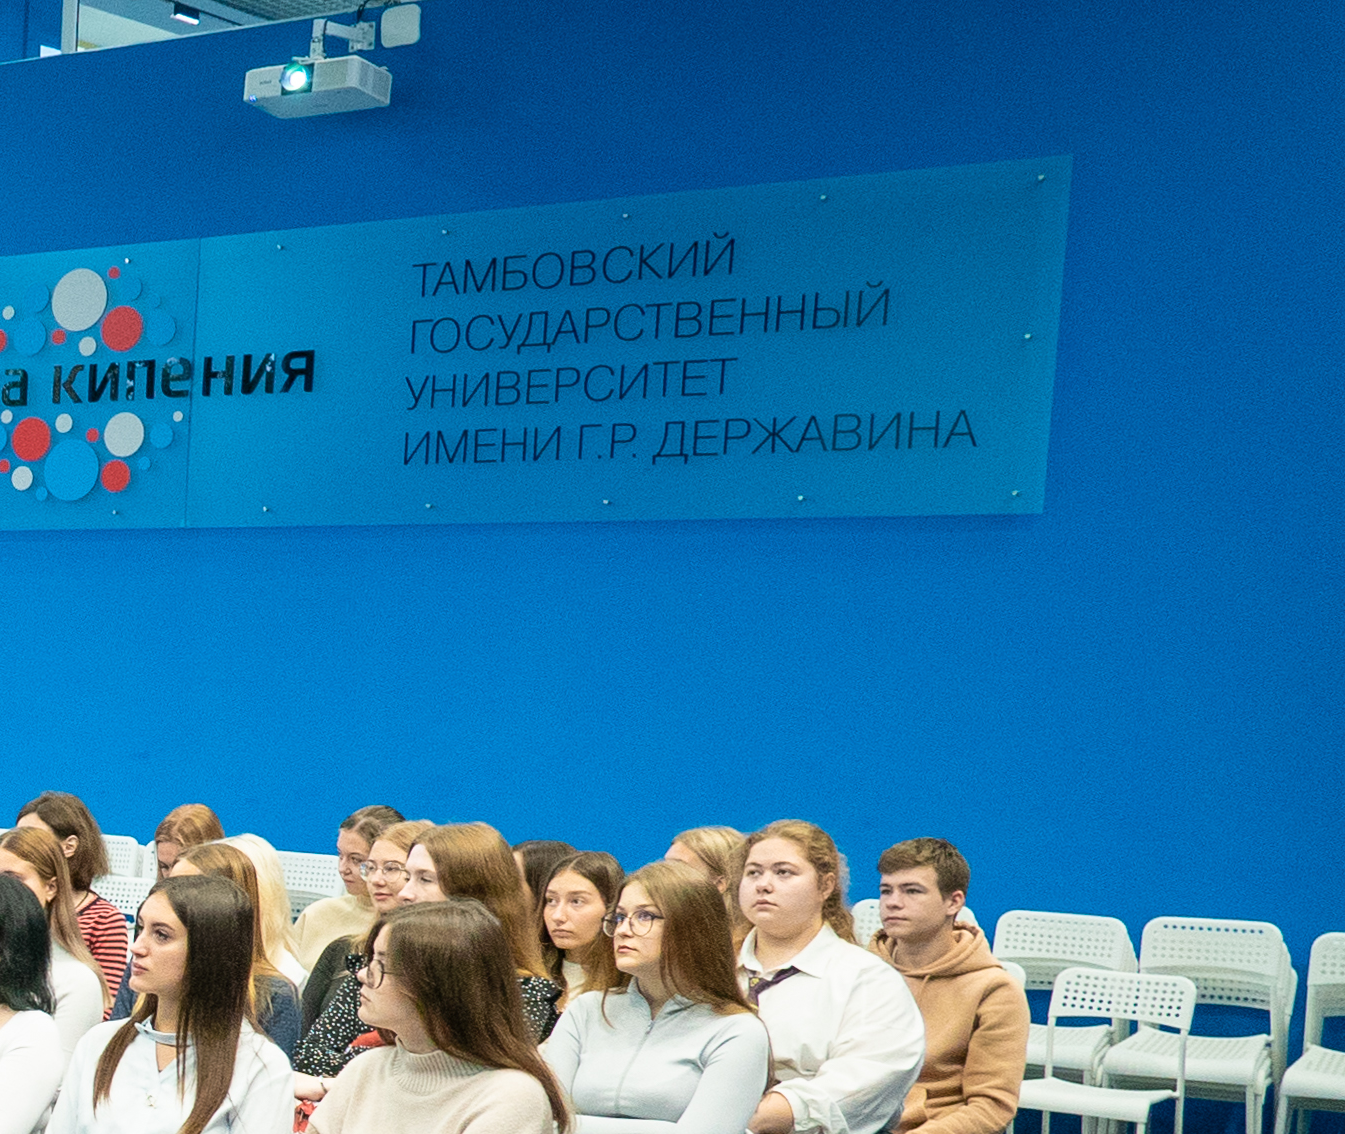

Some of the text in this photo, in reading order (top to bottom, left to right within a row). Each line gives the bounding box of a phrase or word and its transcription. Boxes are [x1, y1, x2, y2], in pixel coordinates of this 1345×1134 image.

[412, 231, 736, 298] ТАМБОВСКИЙ
[410, 279, 891, 355] ГОСУДАРСТВЕННЫЙ
[51, 349, 316, 405] кипения
[404, 357, 738, 411] УНИВЕРСИТЕТ
[402, 408, 978, 466] ИМЕНИ Г.Р. ДЕРЖАВИНА
